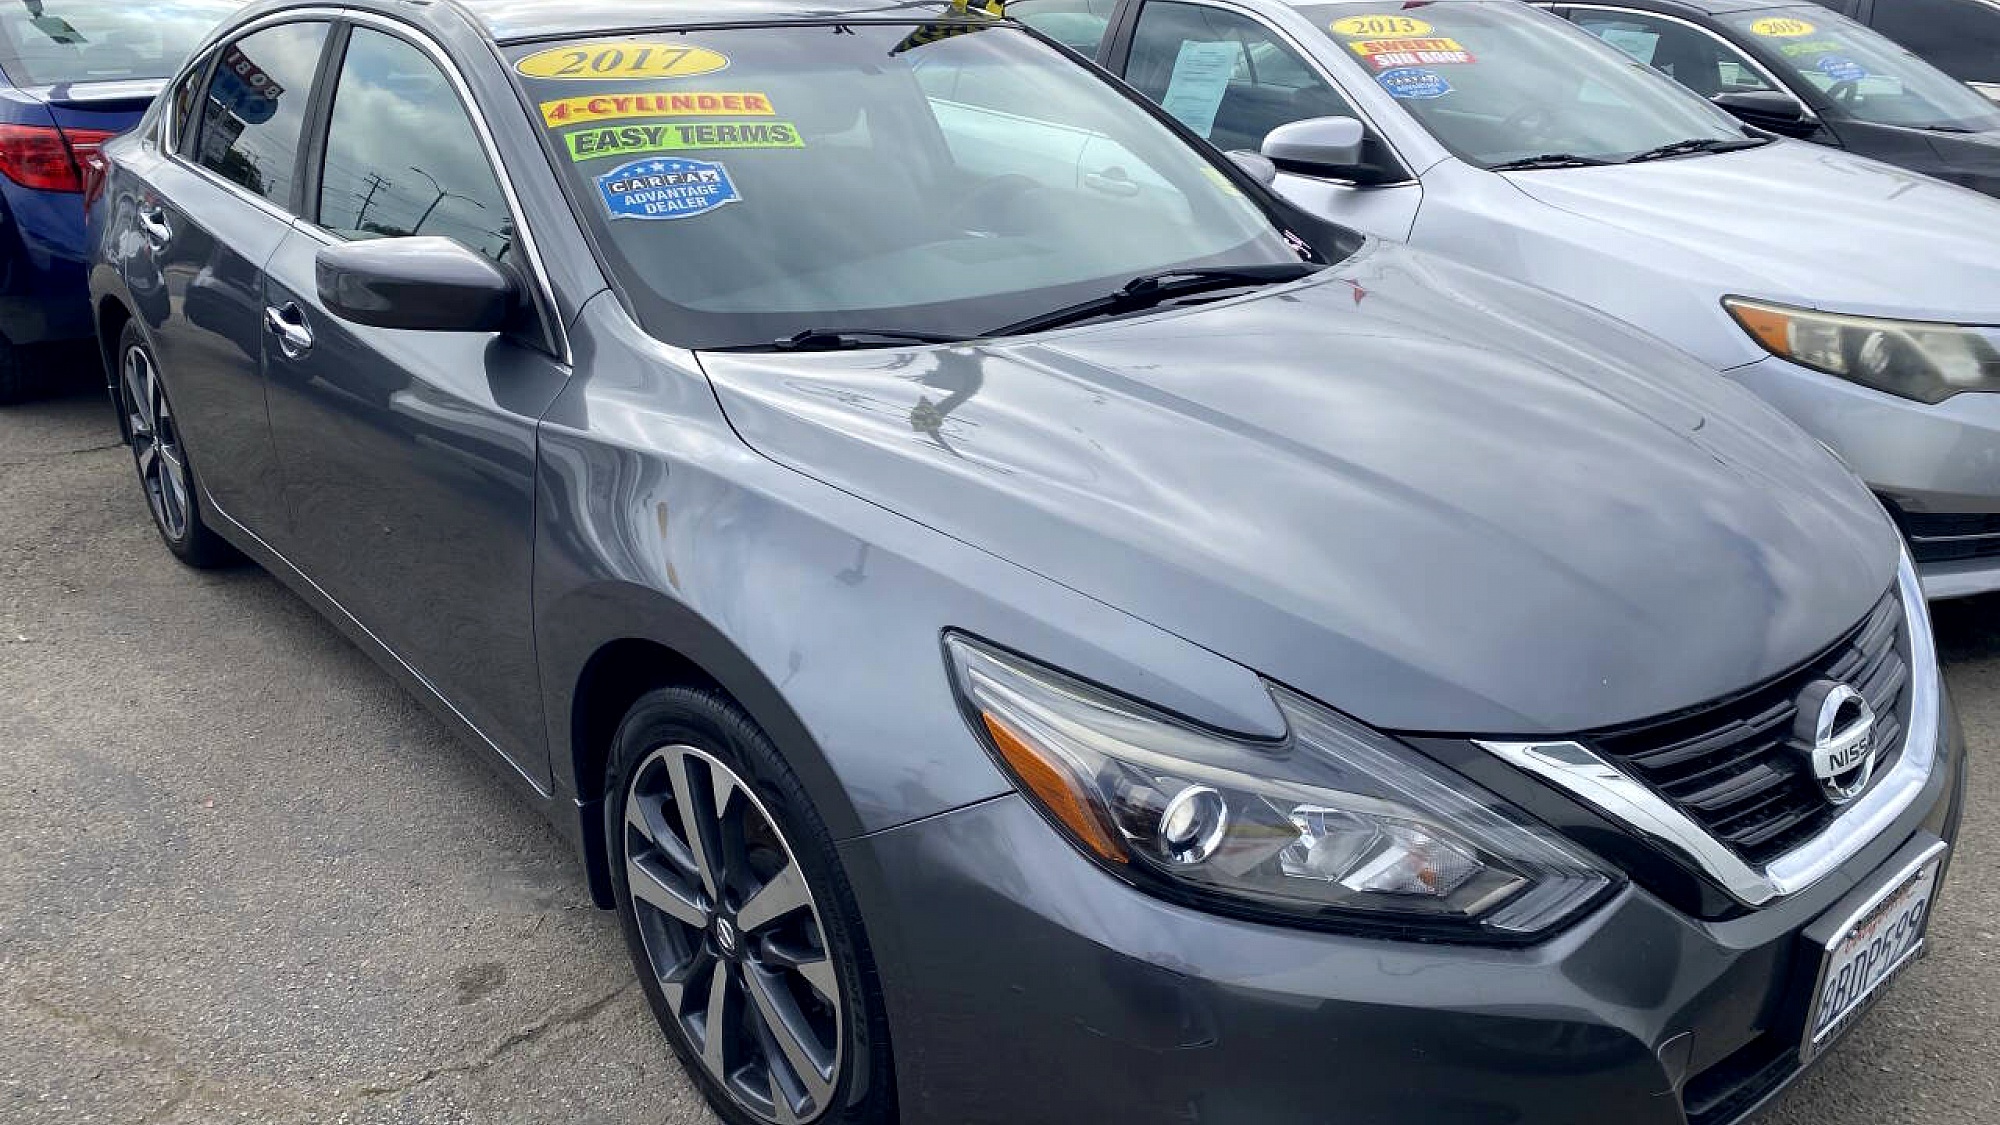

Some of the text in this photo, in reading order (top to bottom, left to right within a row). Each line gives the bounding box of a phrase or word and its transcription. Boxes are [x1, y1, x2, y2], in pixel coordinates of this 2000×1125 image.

[1353, 19, 1415, 34] 2013
[1362, 39, 1450, 53] SWEET!
[556, 48, 690, 75] 2017
[1374, 52, 1468, 66] SUN ROOF
[549, 96, 766, 120] 4-CYLINDER
[574, 125, 794, 154] EASY TERMS
[609, 170, 721, 193] CARFAX
[624, 184, 719, 206] ADVANTAGE
[645, 196, 709, 214] DEALER
[1829, 733, 1873, 771] NISS
